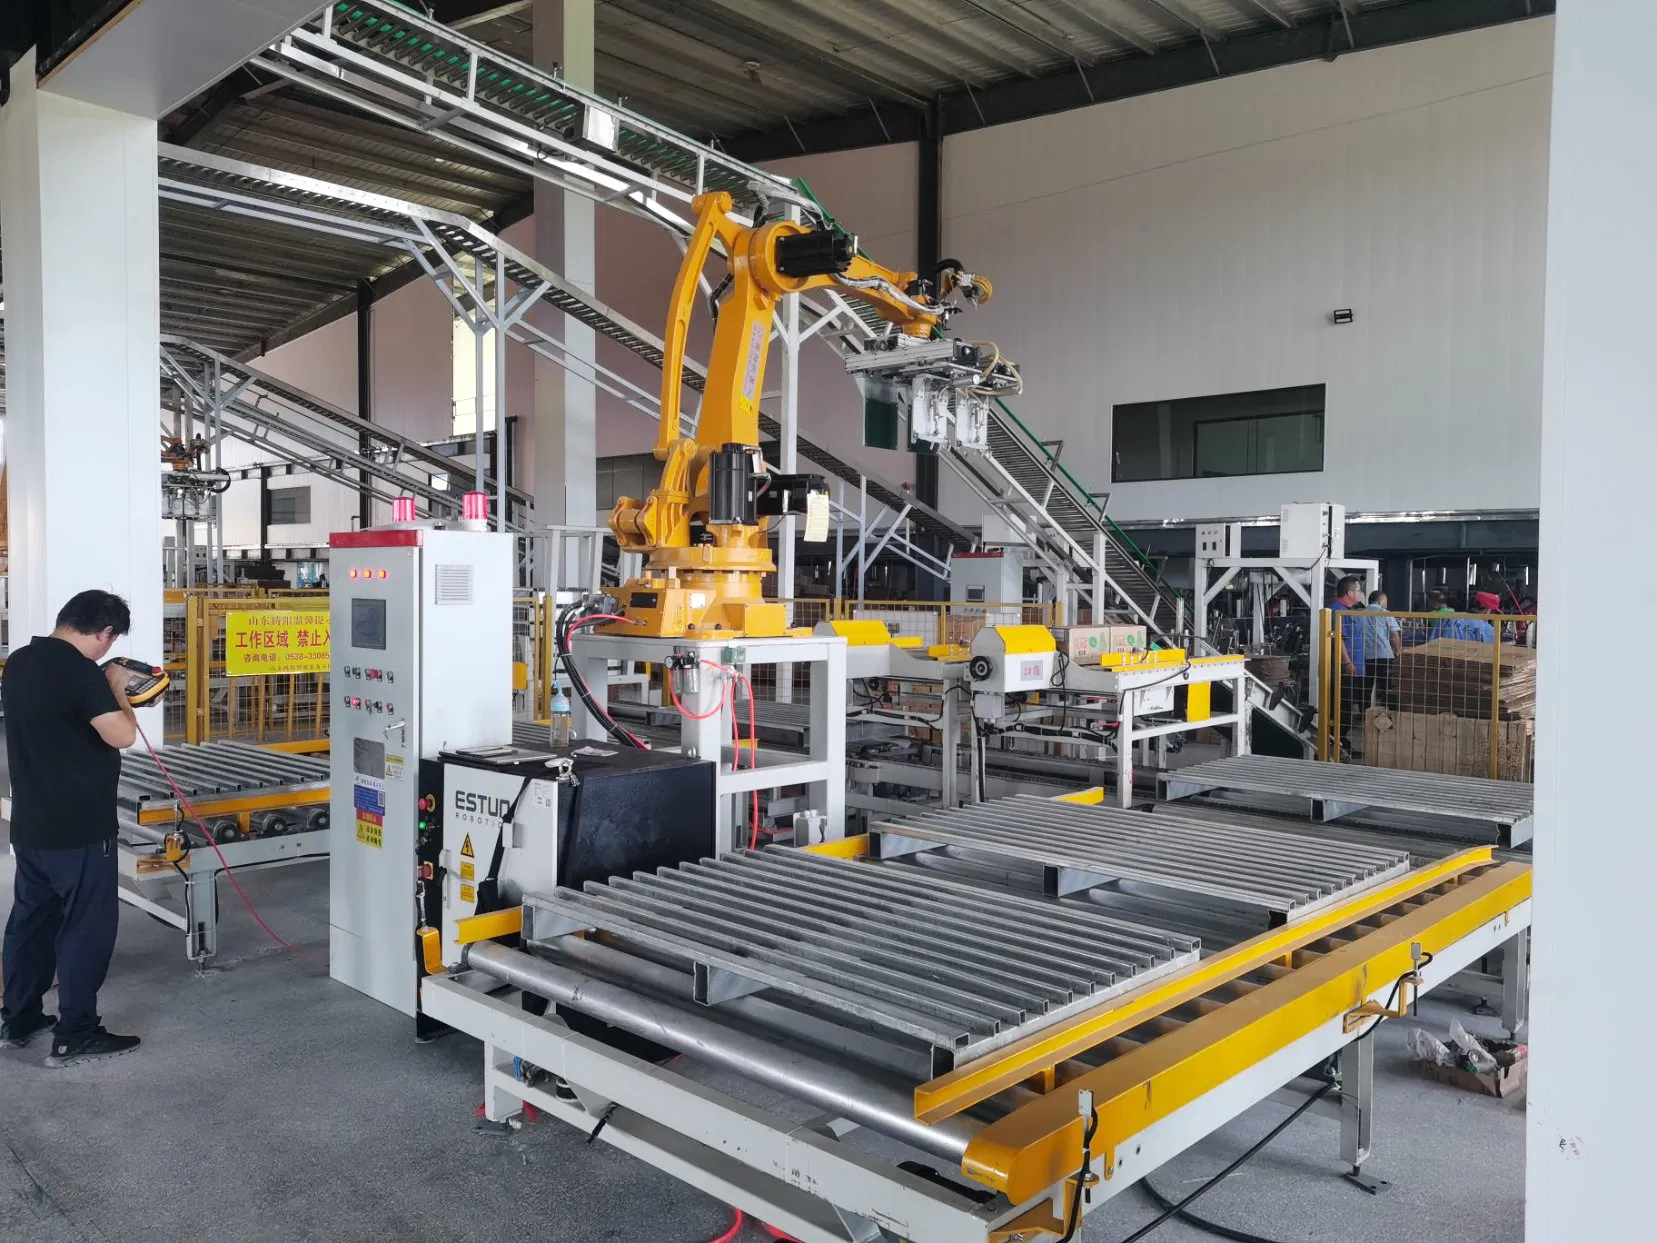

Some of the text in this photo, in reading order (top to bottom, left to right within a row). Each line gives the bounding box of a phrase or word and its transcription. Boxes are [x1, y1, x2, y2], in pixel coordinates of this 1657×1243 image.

[249, 615, 330, 626] 山东腾阳温馨提
[235, 630, 289, 649] 工作区域
